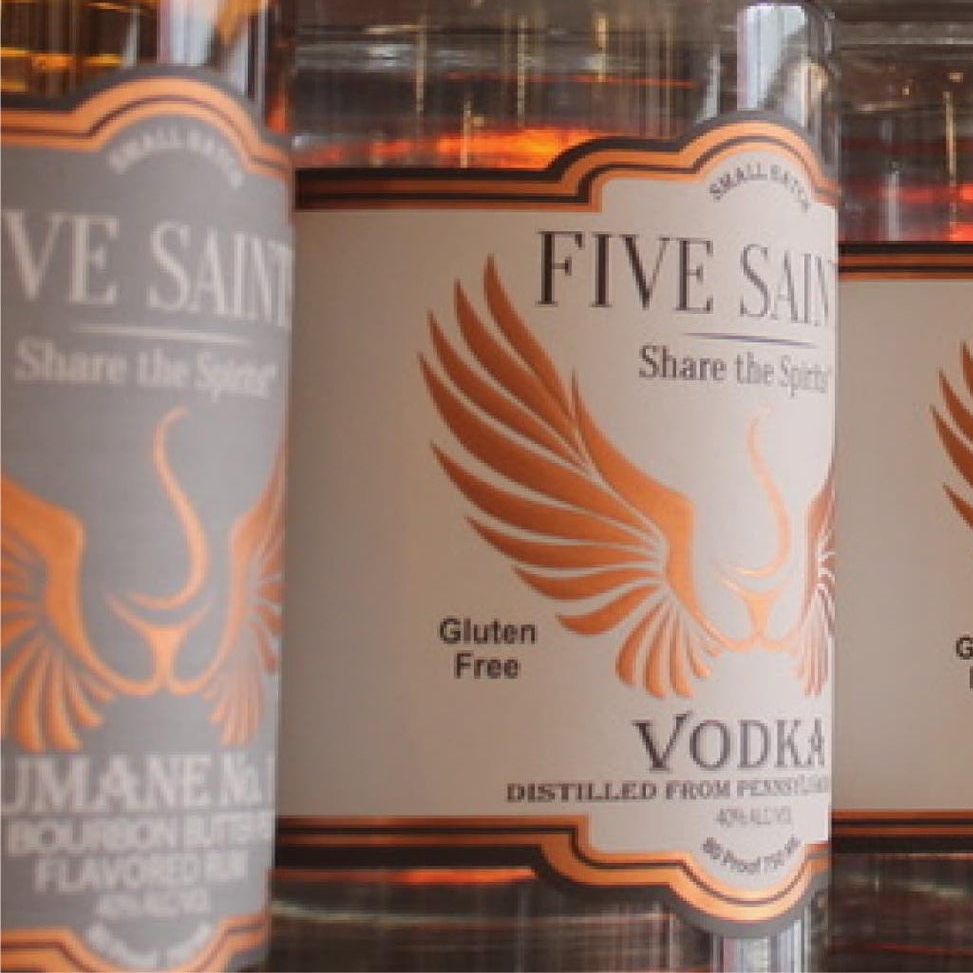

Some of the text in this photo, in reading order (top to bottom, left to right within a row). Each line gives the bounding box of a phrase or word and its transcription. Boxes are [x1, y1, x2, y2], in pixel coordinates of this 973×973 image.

[708, 162, 767, 201] SMALL
[536, 230, 713, 315] FIVE
[14, 336, 128, 384] Share
[137, 349, 190, 387] the
[638, 343, 727, 381] Share
[735, 351, 774, 385] the
[439, 617, 538, 645] Gluten
[454, 651, 521, 679] Free
[633, 710, 826, 771] VODKA
[506, 782, 658, 803] DISTILLED
[665, 780, 731, 802] FROM
[719, 846, 761, 876] Proof
